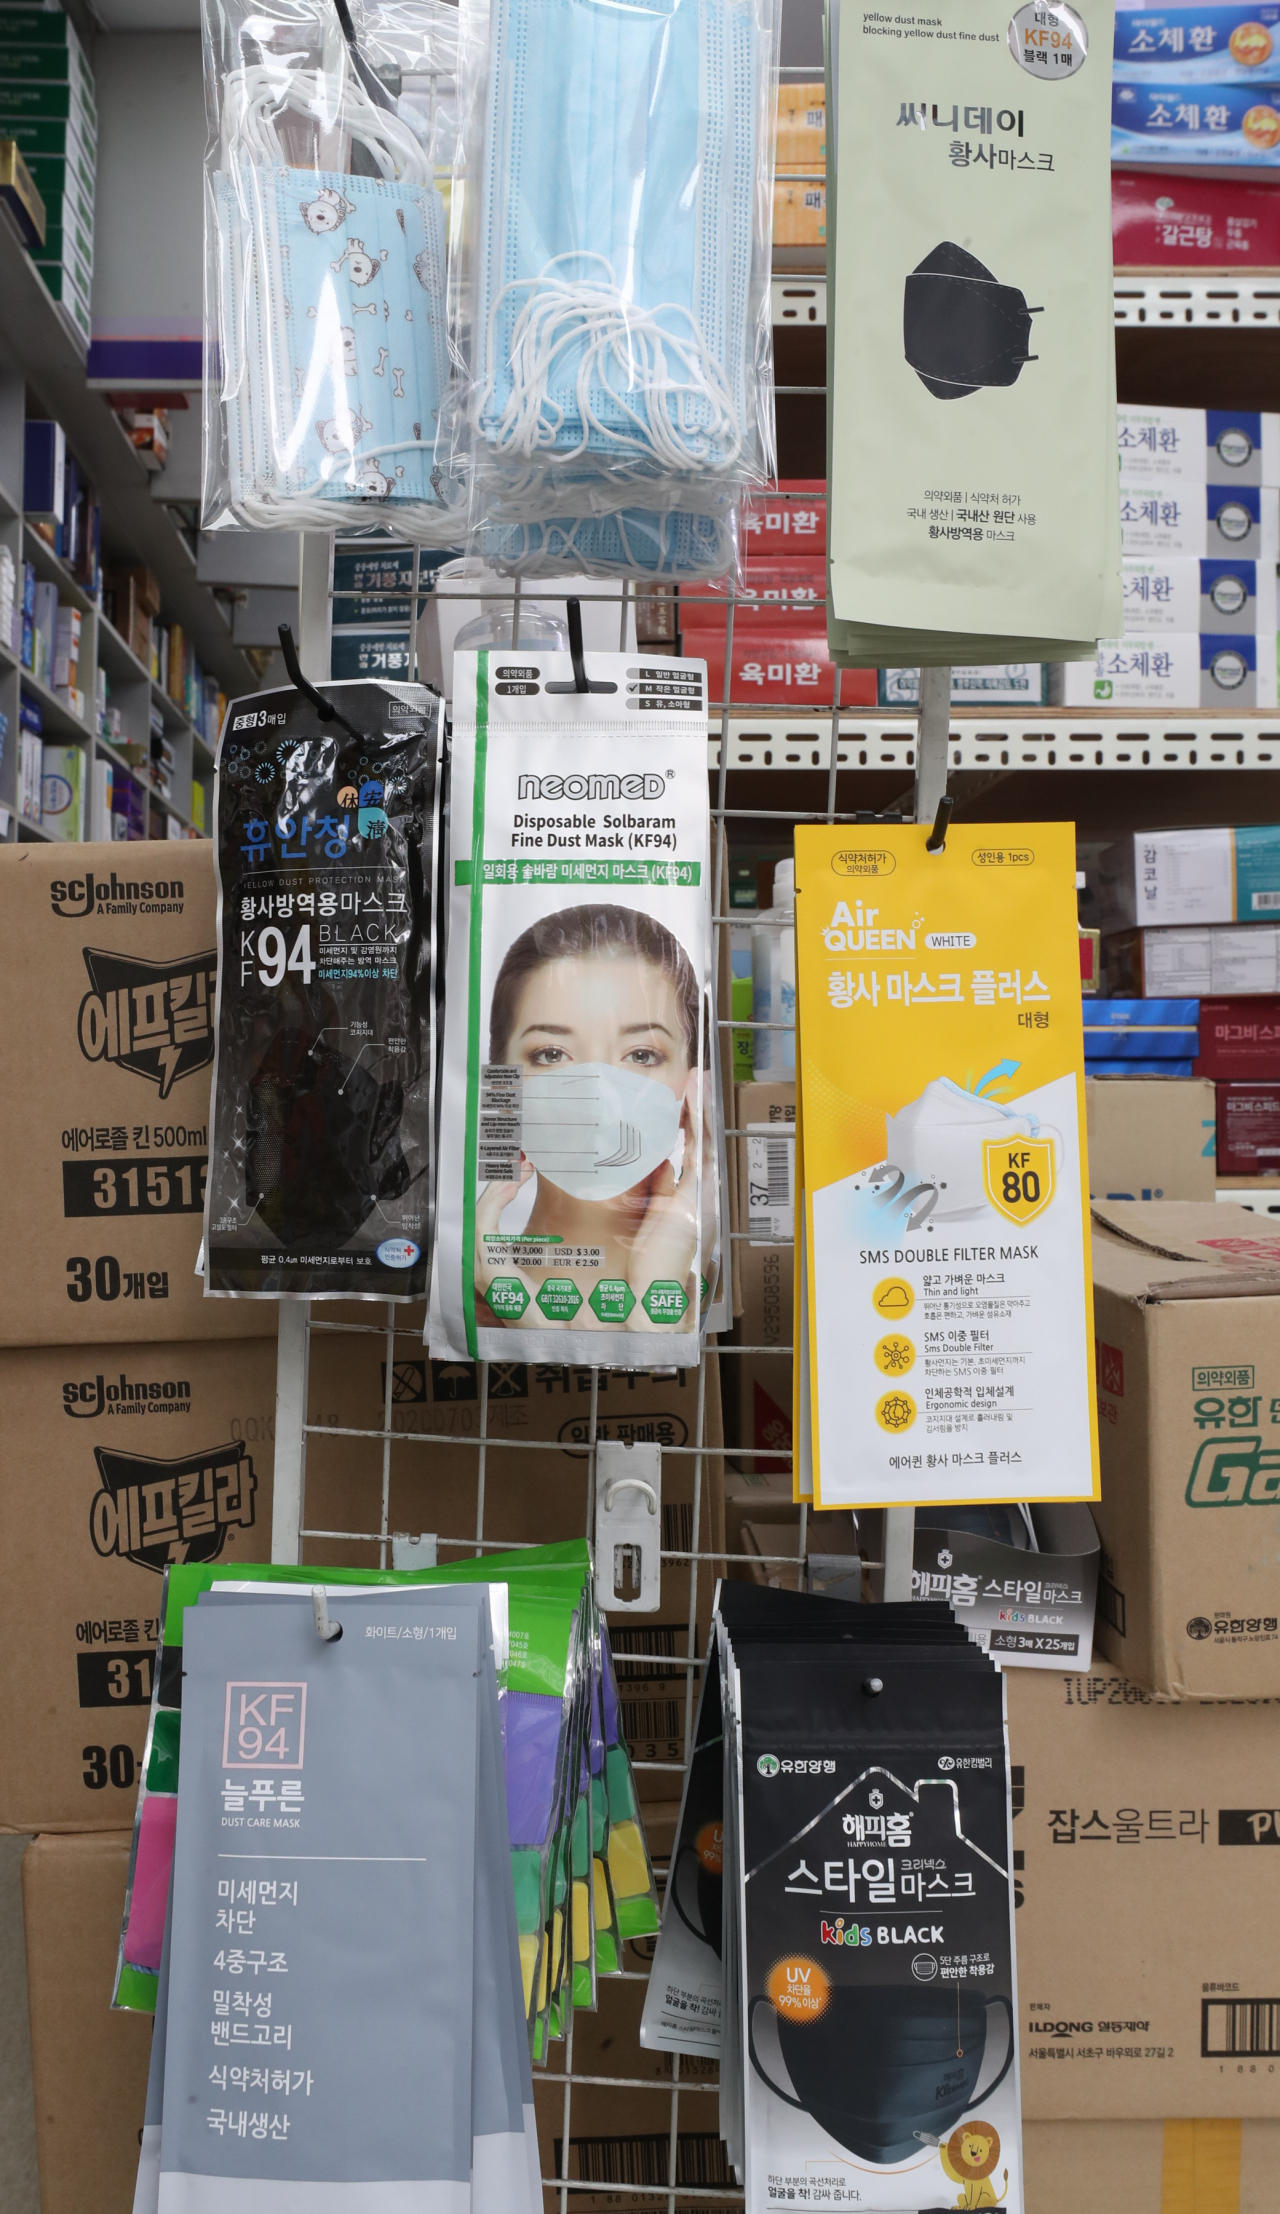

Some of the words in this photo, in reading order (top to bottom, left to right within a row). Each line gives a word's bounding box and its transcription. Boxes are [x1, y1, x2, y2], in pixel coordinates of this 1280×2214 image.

[863, 13, 892, 23] yellow
[895, 14, 915, 24] dust
[918, 16, 942, 26] mask
[863, 26, 902, 38] blocking
[904, 28, 934, 40] yellow
[936, 30, 957, 40] dust
[959, 32, 976, 41] fine
[979, 32, 1000, 42] dust
[1025, 28, 1072, 49] KF94
[1128, 25, 1218, 53] 소체환
[1024, 49, 1048, 64] 블랙
[896, 102, 1024, 138] 써니데이
[1146, 103, 1232, 132] 소체환
[948, 140, 1055, 171] 황사마스크
[1002, 494, 1022, 506] 허가
[906, 508, 928, 520] 국내
[986, 530, 1016, 542] 마스크
[1103, 652, 1174, 678] 소체환
[738, 666, 822, 696] 육미환
[514, 813, 596, 834] Disposable
[602, 814, 676, 828] Solbaram
[240, 814, 350, 863] 휴안청
[511, 832, 544, 848] Fine
[547, 833, 582, 848] Dust
[586, 833, 624, 848] Mask
[628, 832, 677, 851] (KF94)
[838, 852, 887, 864] 식약처허가
[976, 852, 1004, 864] 성인용
[483, 863, 518, 880] 일회용
[562, 864, 609, 880] 미세먼지
[612, 864, 649, 878] 마스크
[846, 864, 879, 875] 의약외품
[279, 878, 304, 886] DUST
[308, 876, 371, 885] PROTECTION
[106, 902, 138, 916] Family
[140, 901, 184, 914] Company
[240, 892, 408, 922] 황사방역용마스크
[830, 899, 880, 928] Air
[318, 924, 396, 942] BLACK
[824, 928, 916, 952] QUEEN
[932, 936, 971, 947] WHITE
[258, 924, 316, 988] 94
[382, 969, 398, 980] 차단
[827, 970, 880, 1009] 황사
[886, 970, 965, 1007] 마스크
[970, 968, 1051, 1006] 플러스
[1018, 1012, 1050, 1029] 대형
[62, 1126, 128, 1152] 에어로졸
[154, 1125, 207, 1148] 500ml
[1008, 1152, 1031, 1169] KF
[1002, 1170, 1040, 1204] 80
[487, 1246, 508, 1254] WON
[554, 1248, 573, 1256] USD
[860, 1250, 890, 1264] SMS
[894, 1249, 949, 1263] DOUBLE
[954, 1247, 996, 1262] FILTER
[1000, 1246, 1040, 1260] MASK
[488, 1258, 506, 1266] CNY
[554, 1258, 572, 1267] EUR
[66, 1256, 168, 1302] 30개입
[944, 1274, 973, 1286] 가벼운
[976, 1273, 1005, 1284] 마스크
[492, 1291, 524, 1305] KF94
[923, 1288, 940, 1297] Thin
[942, 1287, 958, 1296] and
[960, 1286, 978, 1297] light
[650, 1295, 683, 1308] SAFE
[924, 1332, 946, 1342] SMS
[948, 1330, 968, 1342] 이중
[970, 1330, 989, 1341] 필터
[924, 1344, 940, 1354] Sms
[942, 1344, 972, 1353] Double
[974, 1343, 994, 1352] Filter
[953, 1368, 972, 1376] SMS
[1196, 1370, 1250, 1387] 의약외품
[924, 1386, 972, 1399] 인체공학적
[976, 1385, 1014, 1398] 입체설계
[116, 1402, 146, 1416] Family
[148, 1402, 191, 1414] Company
[926, 1400, 968, 1411] Ergonomic
[970, 1400, 998, 1410] design
[1193, 1396, 1262, 1430] 유한
[888, 1454, 922, 1470] 에어퀸
[926, 1454, 949, 1468] 황사
[952, 1453, 985, 1467] 마스크
[988, 1452, 1022, 1465] 플러스
[91, 1457, 253, 1555] 에프킬라
[911, 1570, 979, 1607] 해피홈
[982, 1578, 1042, 1605] 스타일
[1043, 1588, 1083, 1605] 마스크
[1028, 1613, 1064, 1626] BLACK
[1214, 1617, 1278, 1634] 유한양행
[76, 1620, 140, 1644] 에어로졸
[365, 1626, 457, 1641] 화이트/소형/1개입
[994, 1635, 1016, 1648] 소형
[238, 1694, 296, 1727] KF
[238, 1726, 290, 1760] 94
[780, 1759, 836, 1774] 유한양행
[954, 1757, 993, 1770] 유한킴벌리
[220, 1778, 305, 1814] 늘푸른
[221, 1817, 246, 1828] DUST
[246, 1817, 271, 1828] CARE
[273, 1818, 300, 1829] MASK
[842, 1812, 912, 1848] 해피홈
[1047, 1808, 1210, 1844] 잡스울트라
[846, 1840, 888, 1848] HAPPYHOME
[784, 1857, 896, 1904] 스타일
[900, 1872, 976, 1902] 마스크
[218, 1879, 298, 1906] 미세먼지
[215, 1908, 256, 1935] 차단
[876, 1926, 944, 1944] BLACK
[213, 1948, 289, 1976] 4중구조
[786, 1967, 811, 1983] UV
[940, 1966, 968, 1980] 편안한
[968, 1964, 995, 1978] 착용감
[786, 1984, 812, 1997] 차단율
[213, 1990, 272, 2018] 밀착성
[778, 1994, 802, 2009] 99%
[1028, 2022, 1094, 2033] ILDONG
[1098, 2021, 1150, 2032] 일동제약
[210, 2020, 292, 2051] 밴드고리
[1028, 2047, 1076, 2060] 서울특별시
[1076, 2047, 1104, 2060] 서초구
[1145, 2047, 1166, 2060] 27길
[208, 2064, 314, 2096] 식약처허가
[206, 2108, 291, 2140] 국내생산
[767, 2174, 783, 2186] 하단
[784, 2174, 808, 2187] 부분의
[767, 2186, 796, 2200] 얼굴을
